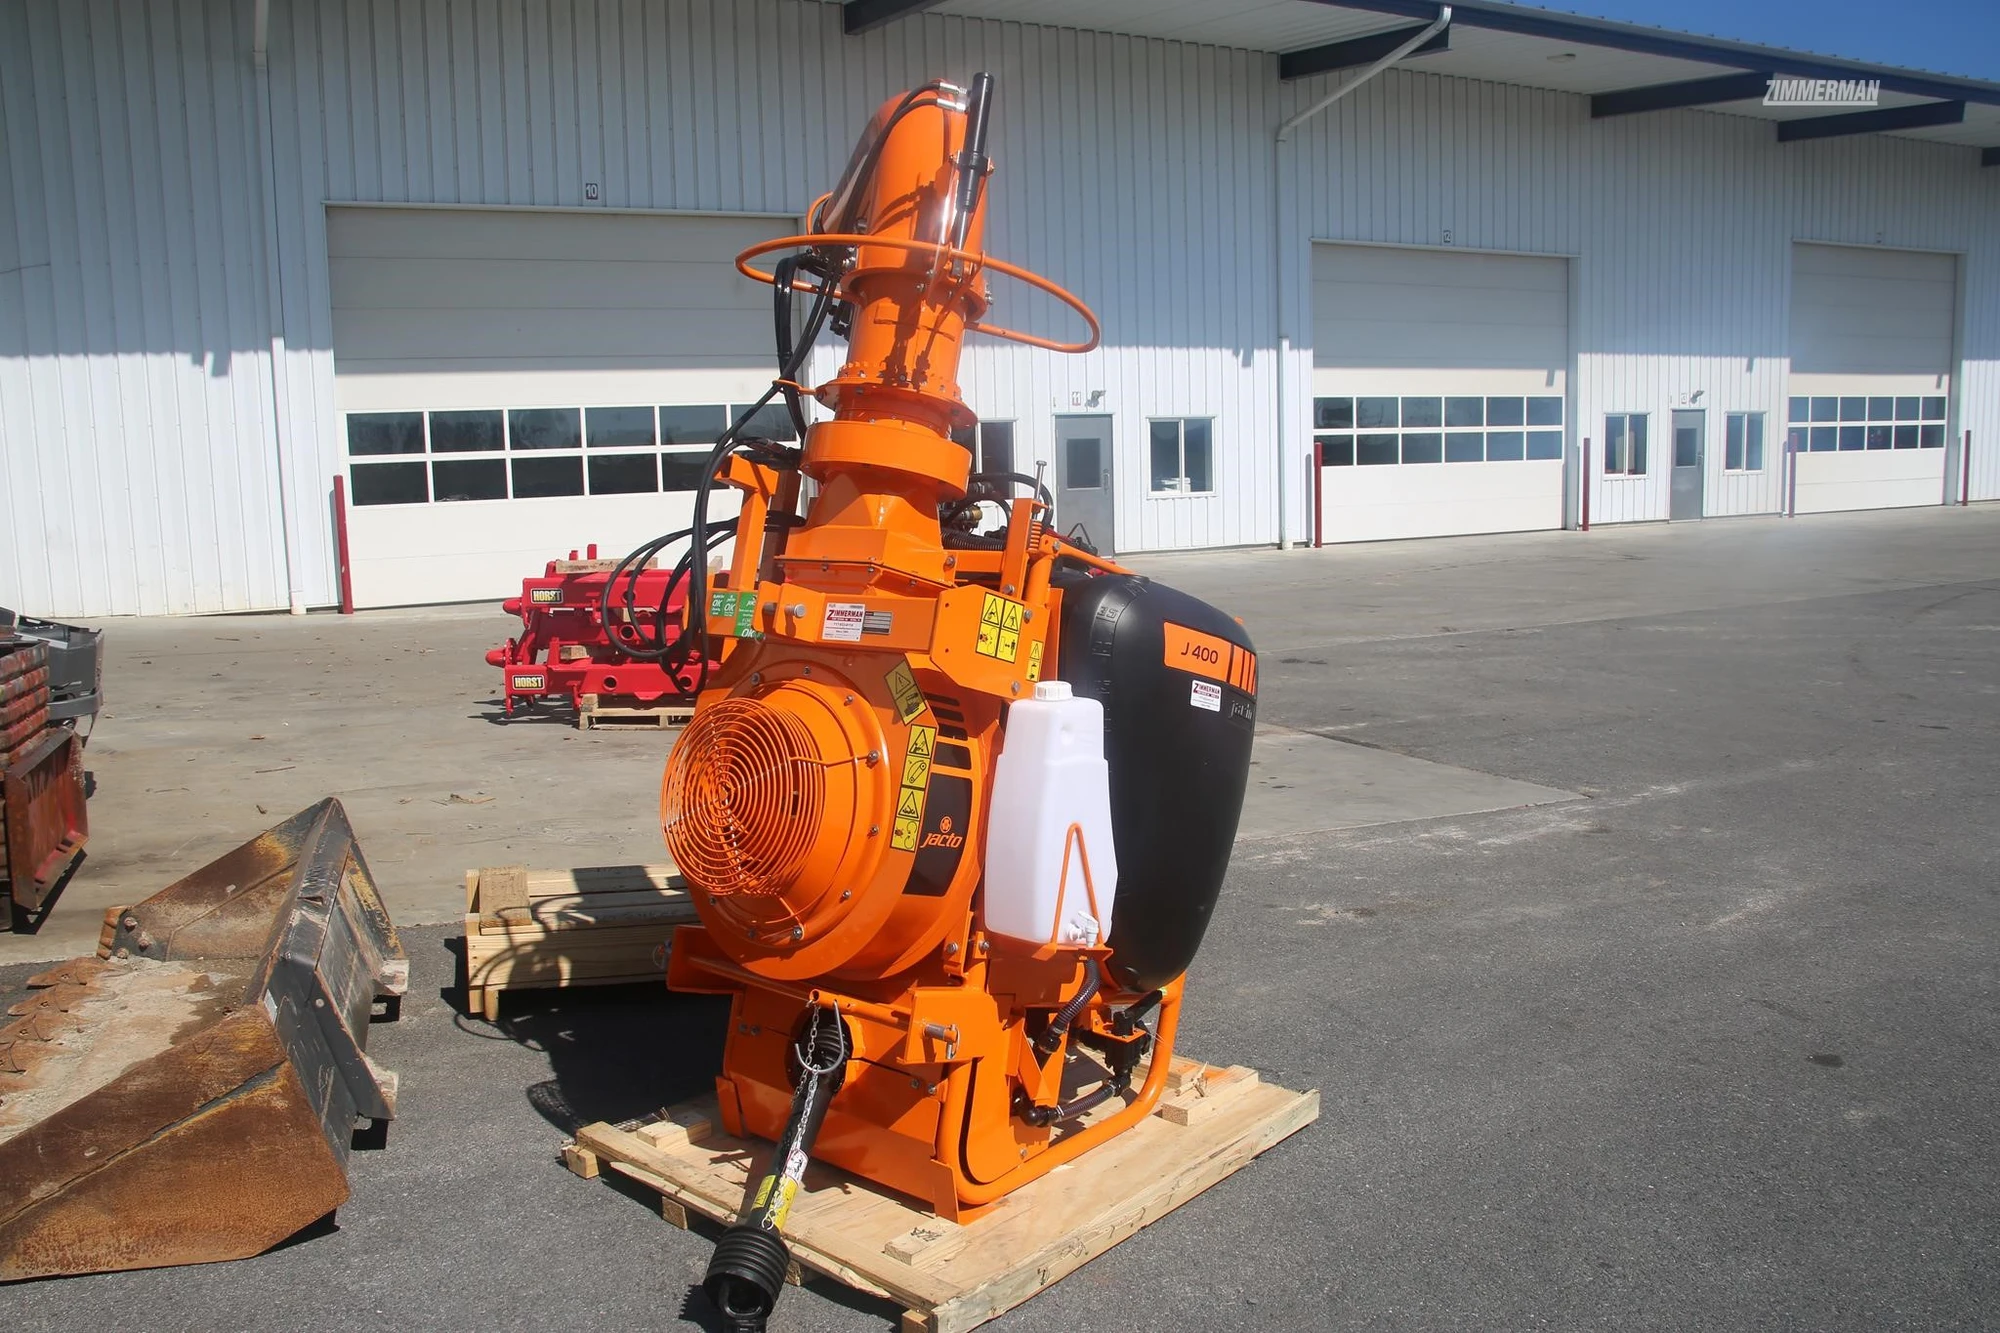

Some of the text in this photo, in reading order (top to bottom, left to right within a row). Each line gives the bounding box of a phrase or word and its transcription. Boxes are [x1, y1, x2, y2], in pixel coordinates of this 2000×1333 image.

[586, 184, 598, 198] 10
[533, 590, 561, 602] HORST
[712, 599, 723, 607] OK
[724, 603, 736, 612] OK
[827, 609, 863, 620] ZIMMERMAN
[741, 628, 755, 638] OK
[1181, 642, 1218, 664] J 400
[514, 677, 543, 688] HORST
[920, 832, 963, 848] jacto
